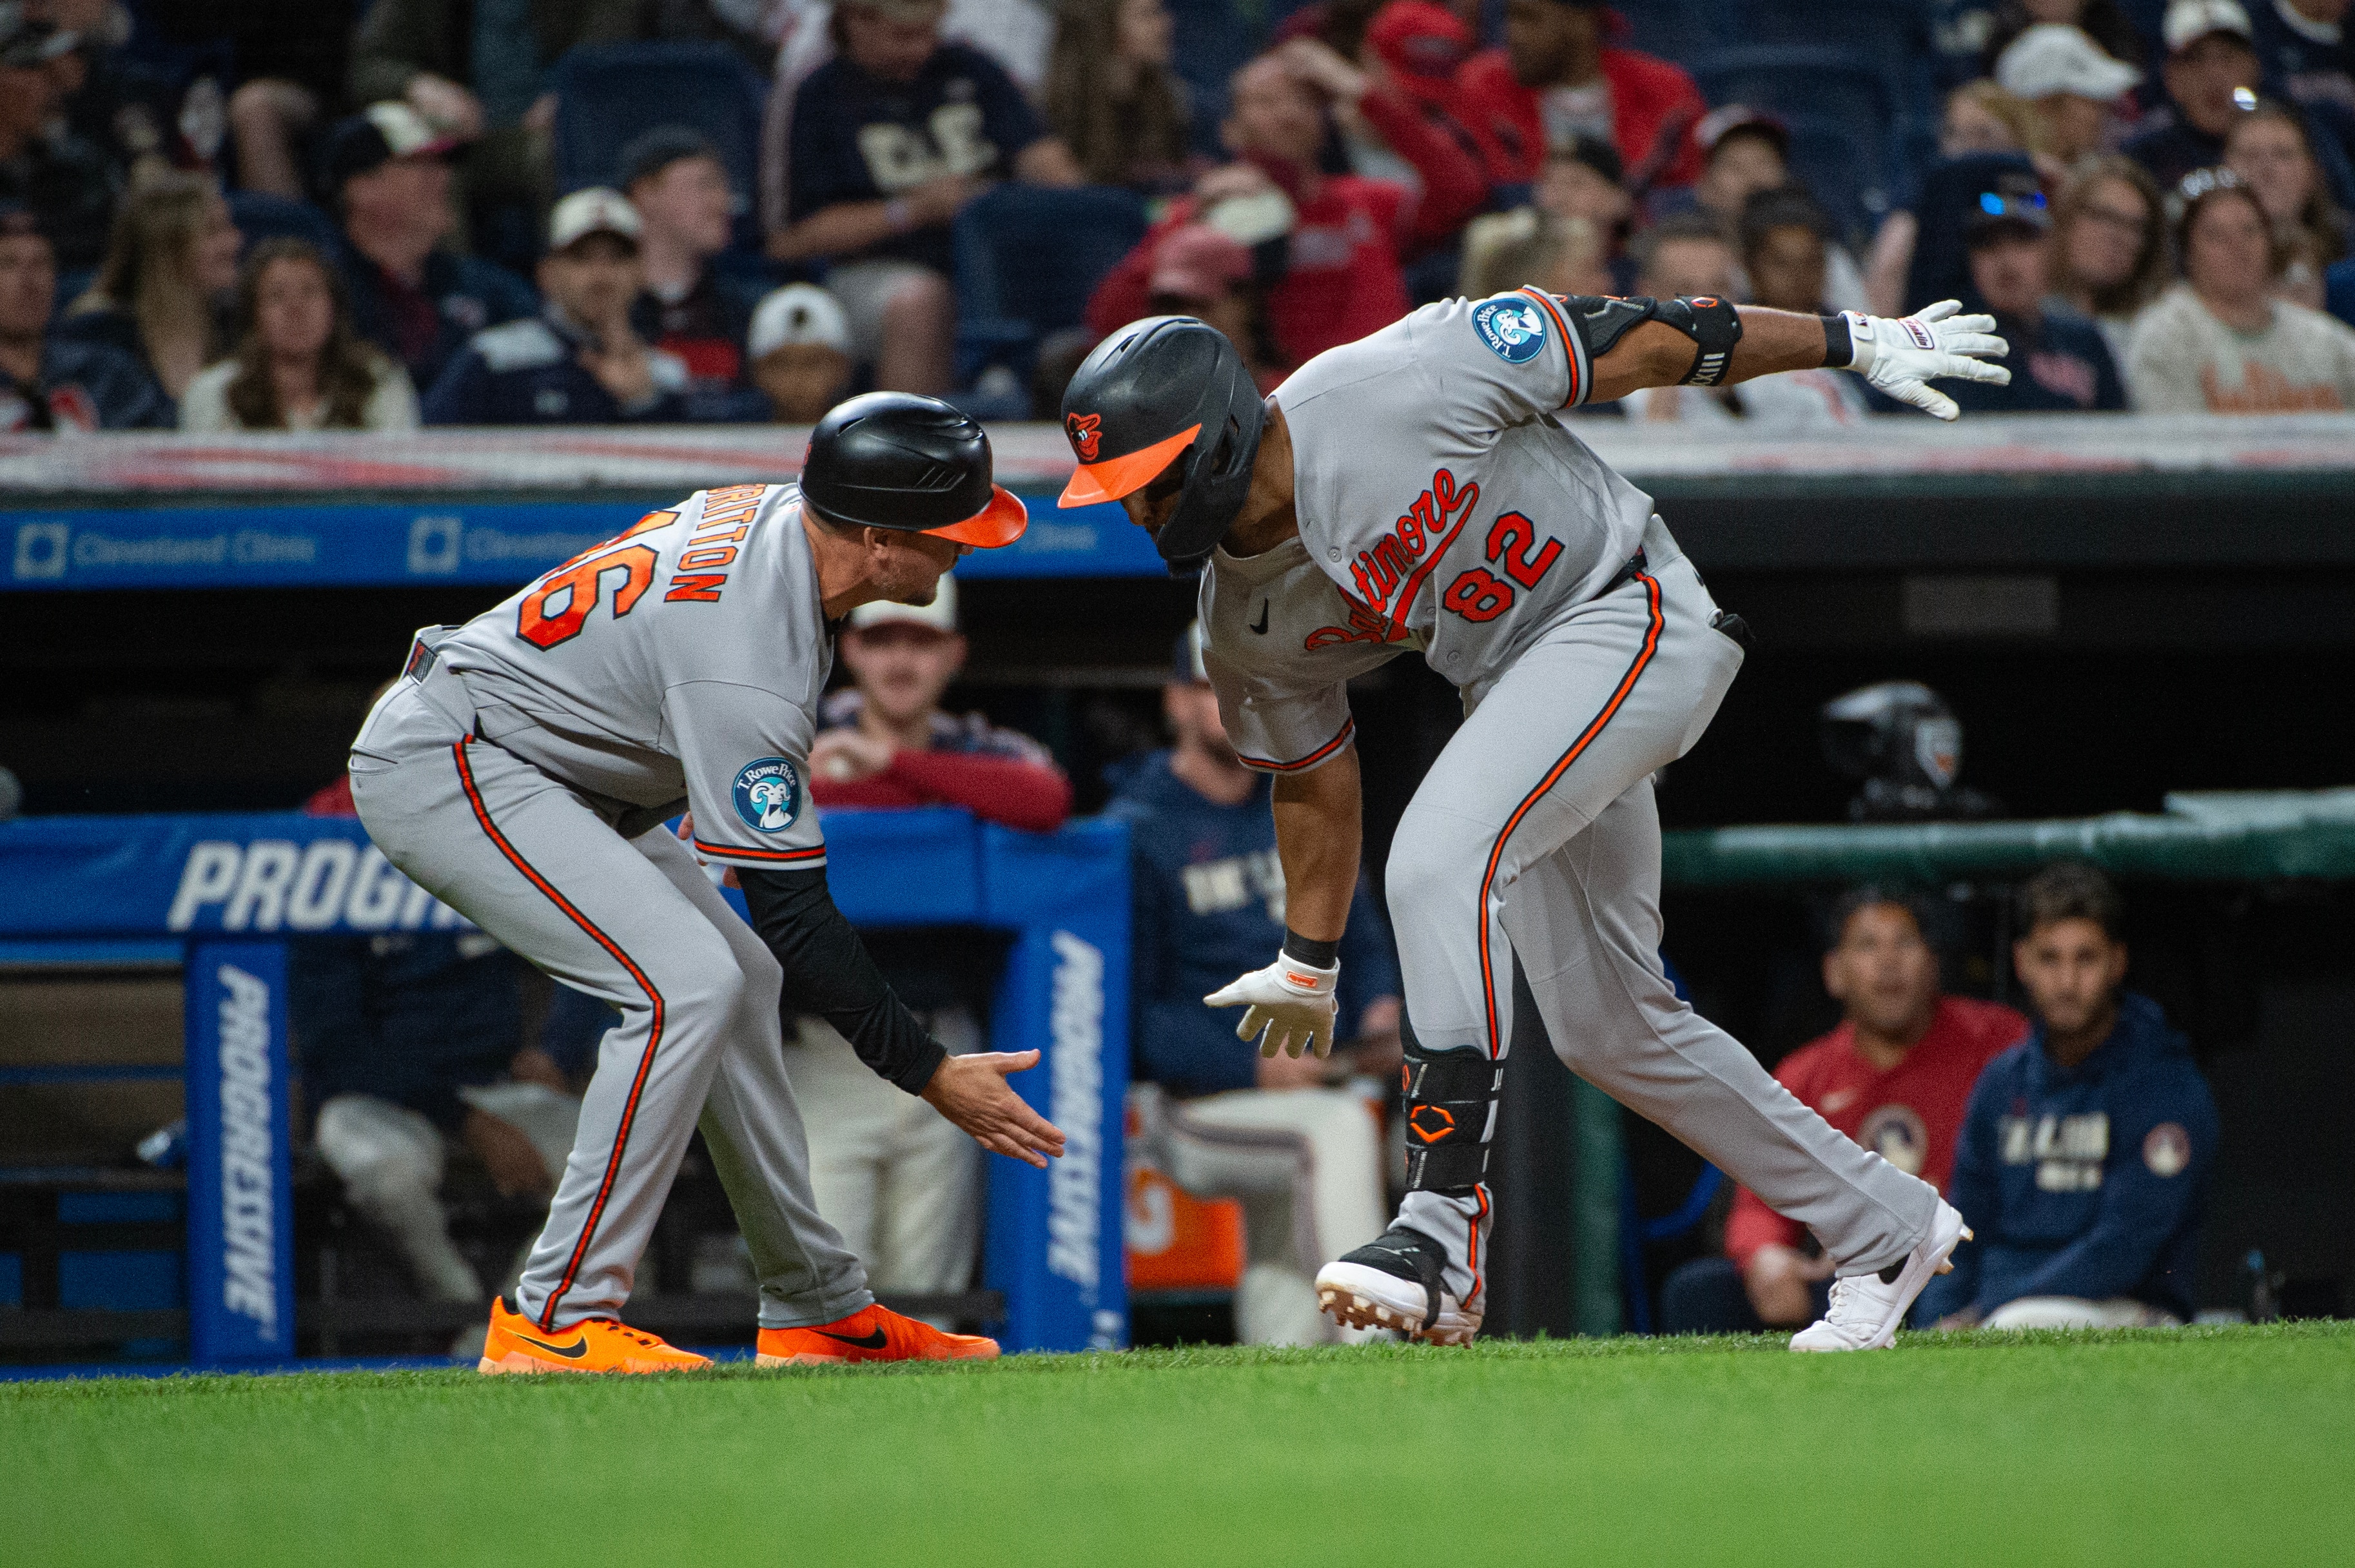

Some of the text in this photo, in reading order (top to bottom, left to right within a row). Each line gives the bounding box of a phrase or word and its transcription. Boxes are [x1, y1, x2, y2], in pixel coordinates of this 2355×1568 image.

[1477, 305, 1498, 322] Price
[1481, 322, 1500, 350] Rowe
[1441, 510, 1566, 624] 82
[745, 765, 779, 783] Rowe
